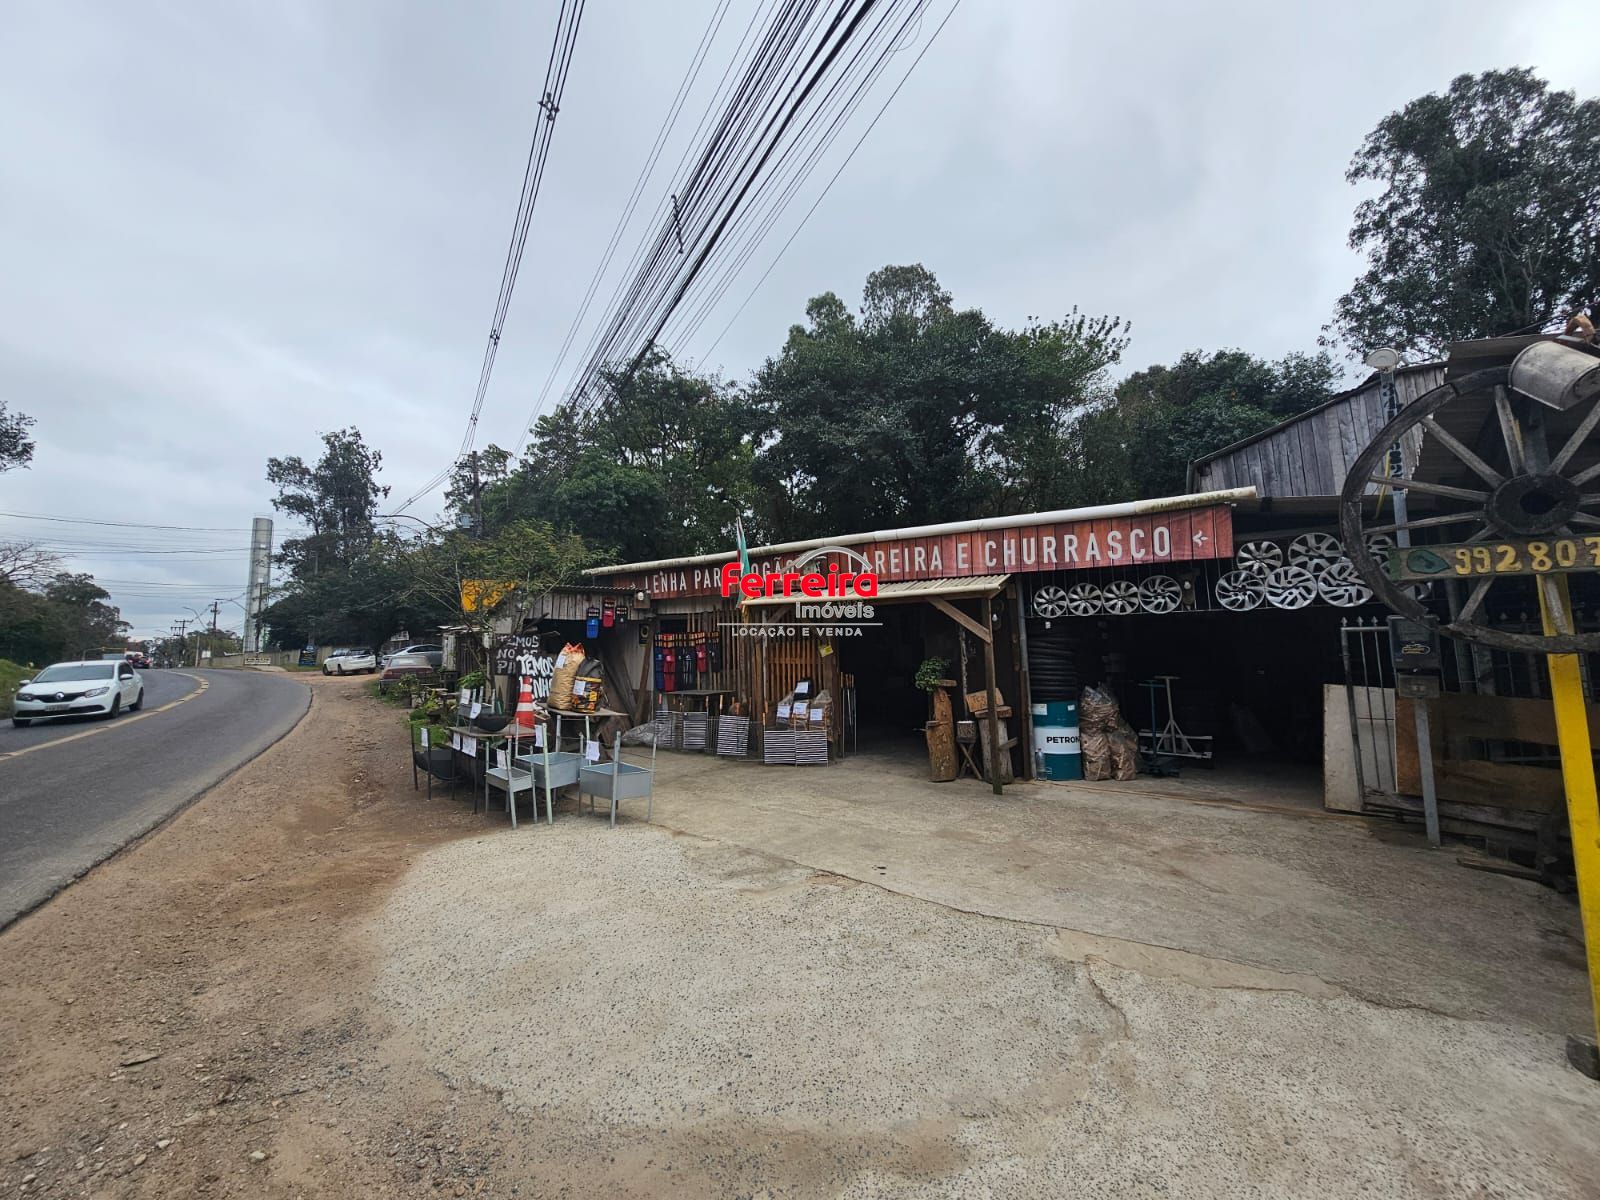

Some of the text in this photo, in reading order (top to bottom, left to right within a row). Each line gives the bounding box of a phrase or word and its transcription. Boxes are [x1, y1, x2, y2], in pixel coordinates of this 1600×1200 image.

[644, 571, 687, 594] LENHA
[695, 566, 731, 590] PAR
[847, 545, 943, 576] LAREIRA
[957, 542, 969, 569] E
[984, 526, 1170, 568] CHURRASCO
[516, 654, 554, 676] TEMOS
